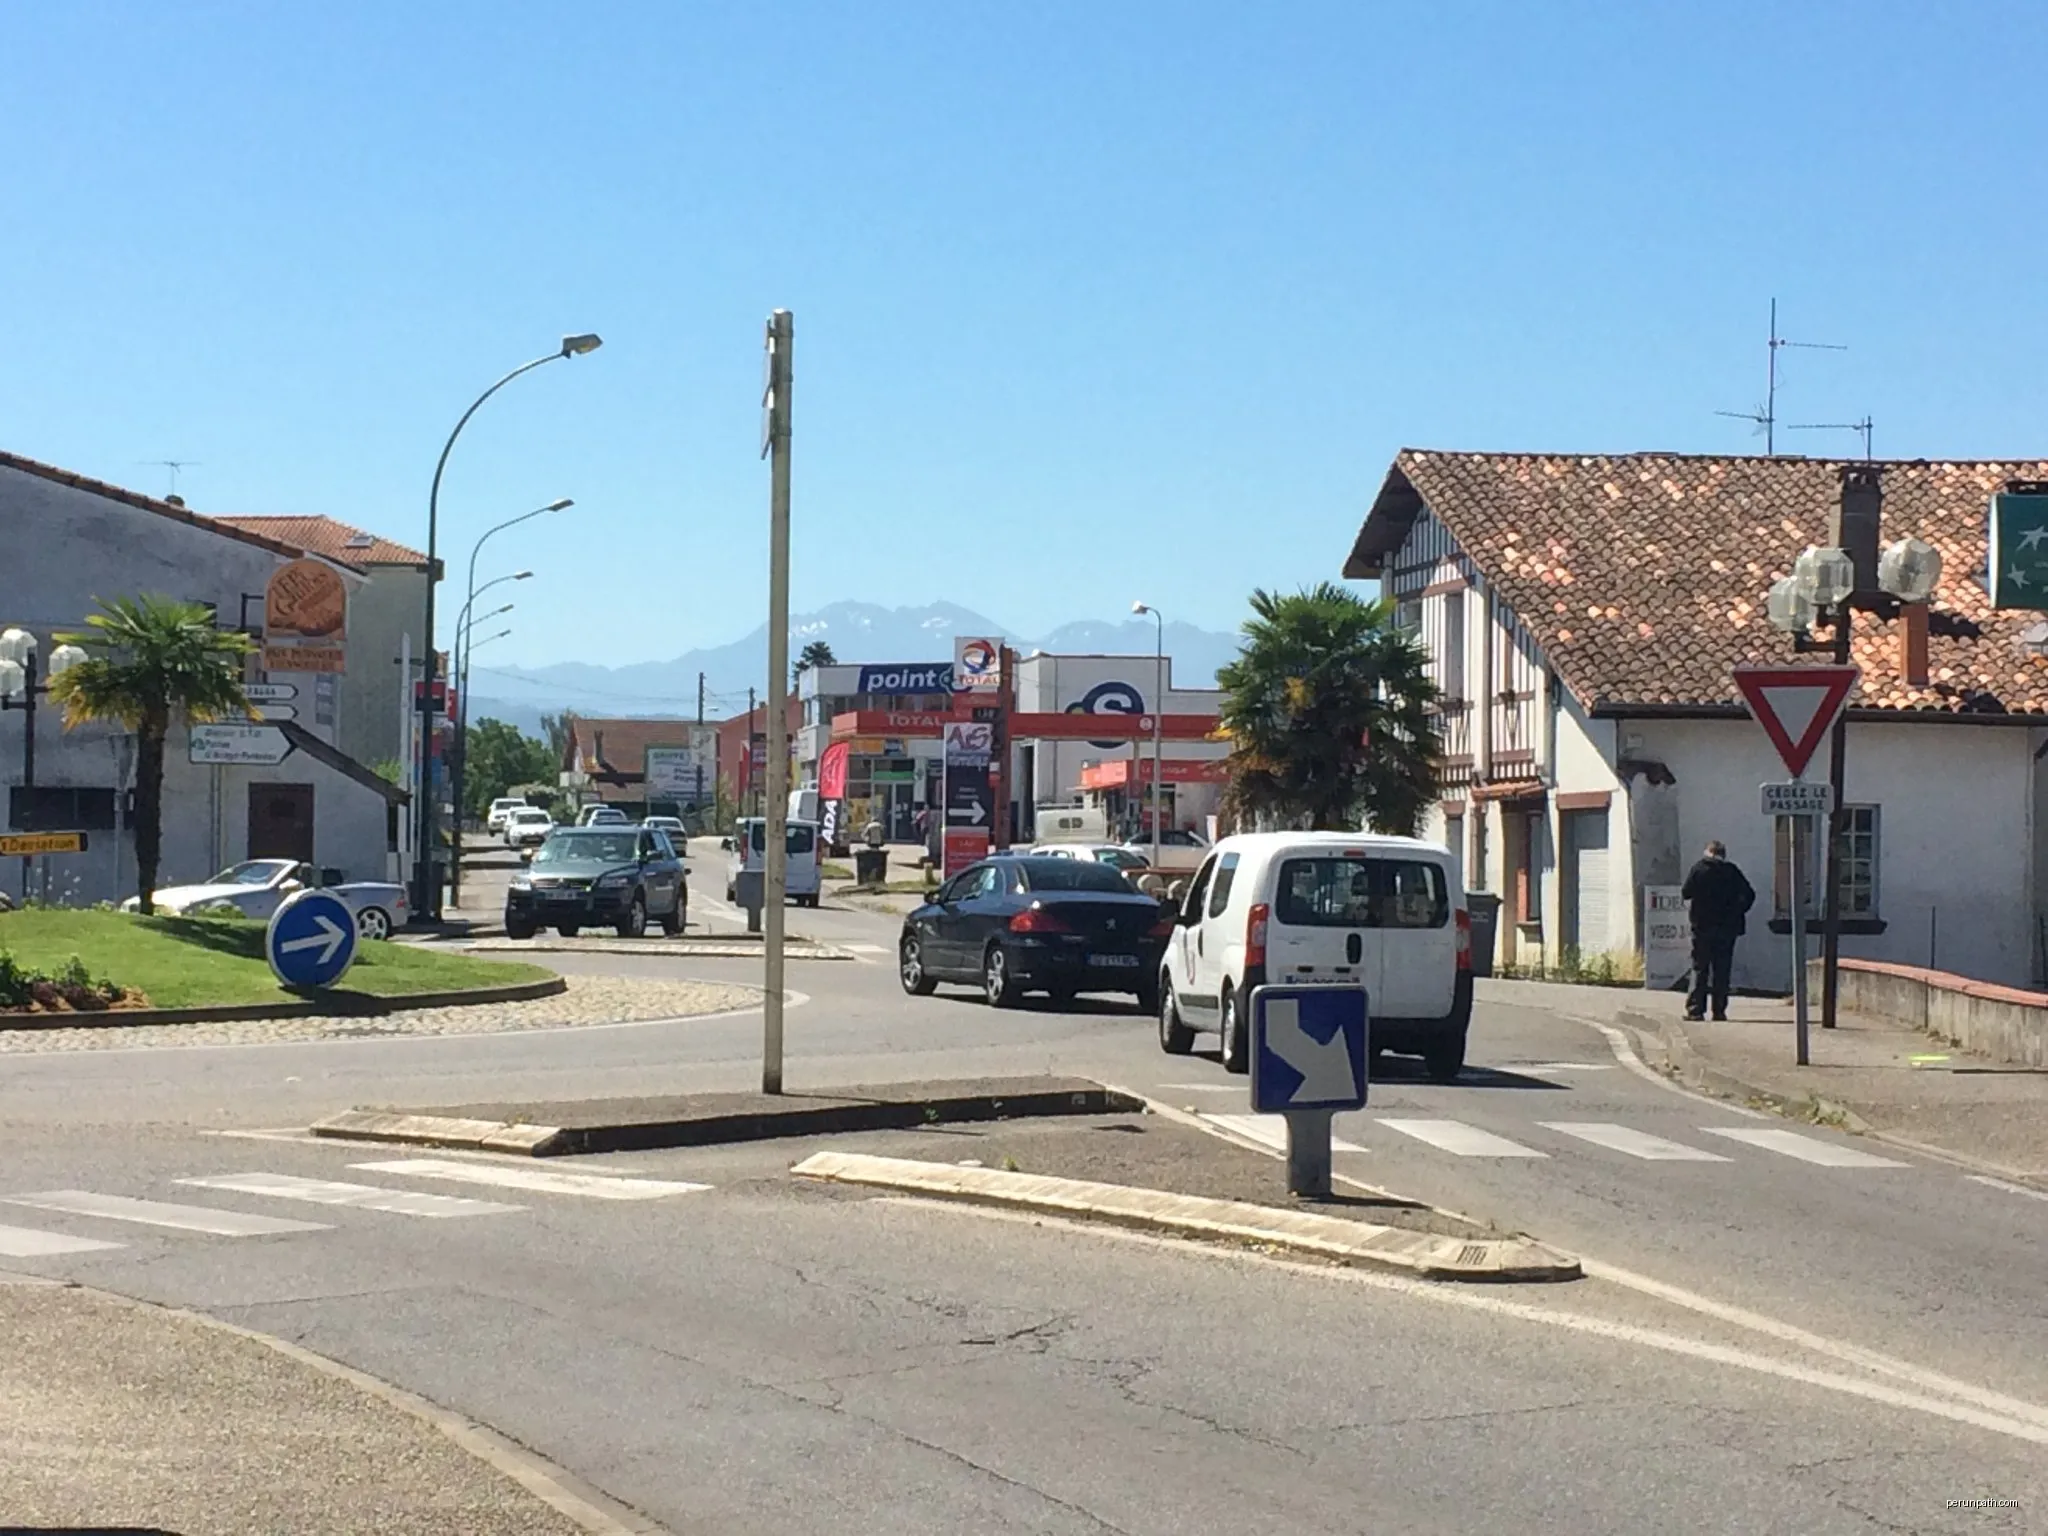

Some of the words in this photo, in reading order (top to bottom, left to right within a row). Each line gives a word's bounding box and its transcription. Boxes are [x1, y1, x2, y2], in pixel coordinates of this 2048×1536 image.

[867, 669, 937, 692] point
[958, 674, 999, 685] TOTAL
[887, 713, 945, 727] TOTAL
[1813, 787, 1827, 798] LE
[1769, 799, 1825, 810] PASSAGE
[821, 799, 838, 844] ADA
